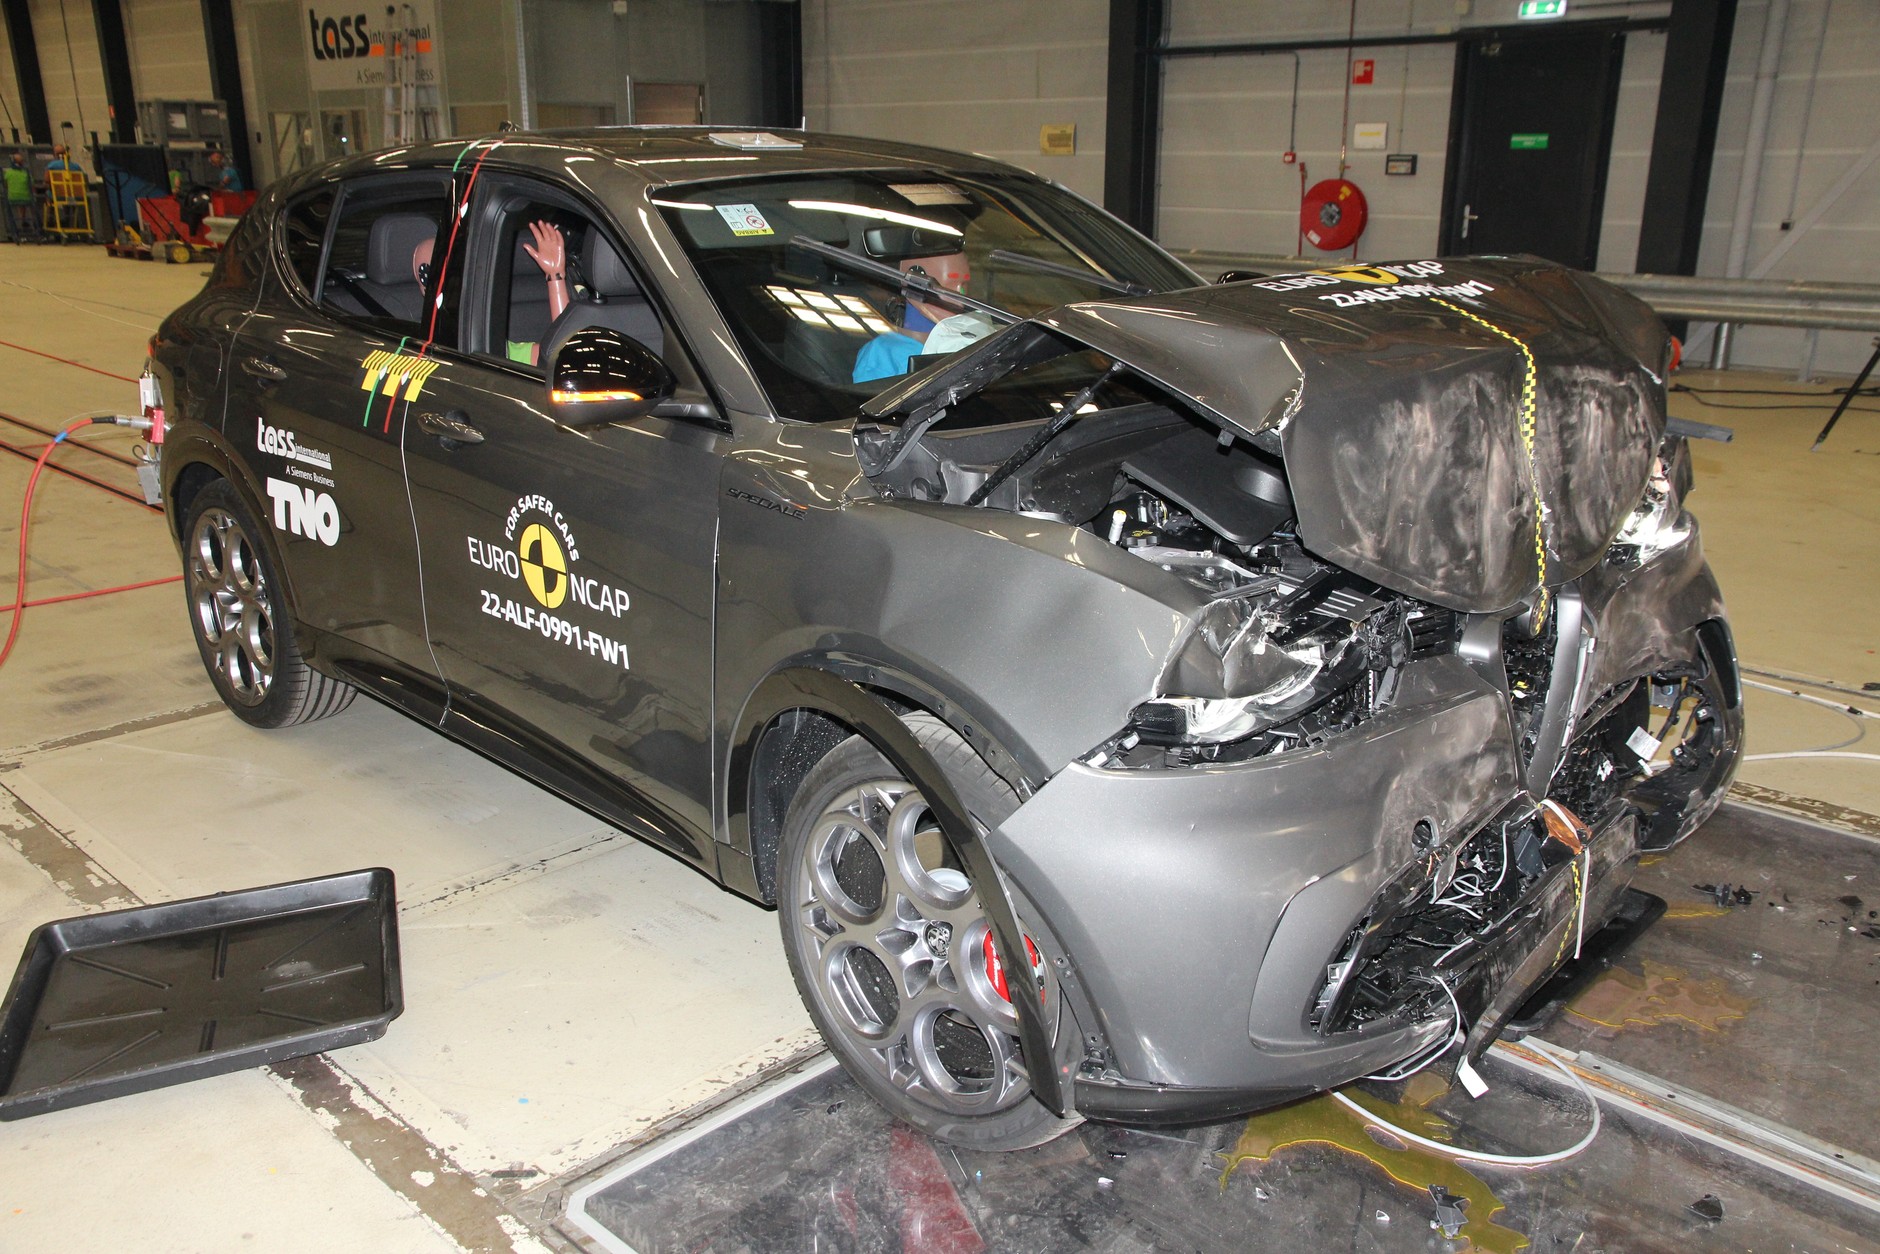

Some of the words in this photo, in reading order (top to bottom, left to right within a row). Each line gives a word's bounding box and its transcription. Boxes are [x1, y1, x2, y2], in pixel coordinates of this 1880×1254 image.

[309, 8, 370, 60] tass
[1252, 274, 1341, 292] EURO
[1376, 260, 1445, 279] NCAP
[257, 416, 297, 460] tass
[295, 442, 331, 463] international
[285, 465, 291, 475] A
[291, 466, 313, 481] Siemens
[313, 472, 335, 488] Business
[267, 477, 340, 547] TNO
[505, 506, 521, 542] FOR
[517, 494, 553, 518] SAFER
[553, 512, 580, 562] CARS
[467, 536, 520, 579] EURO
[570, 572, 630, 618] NCAP
[480, 589, 630, 670] 22-ALF-0991-FW1
